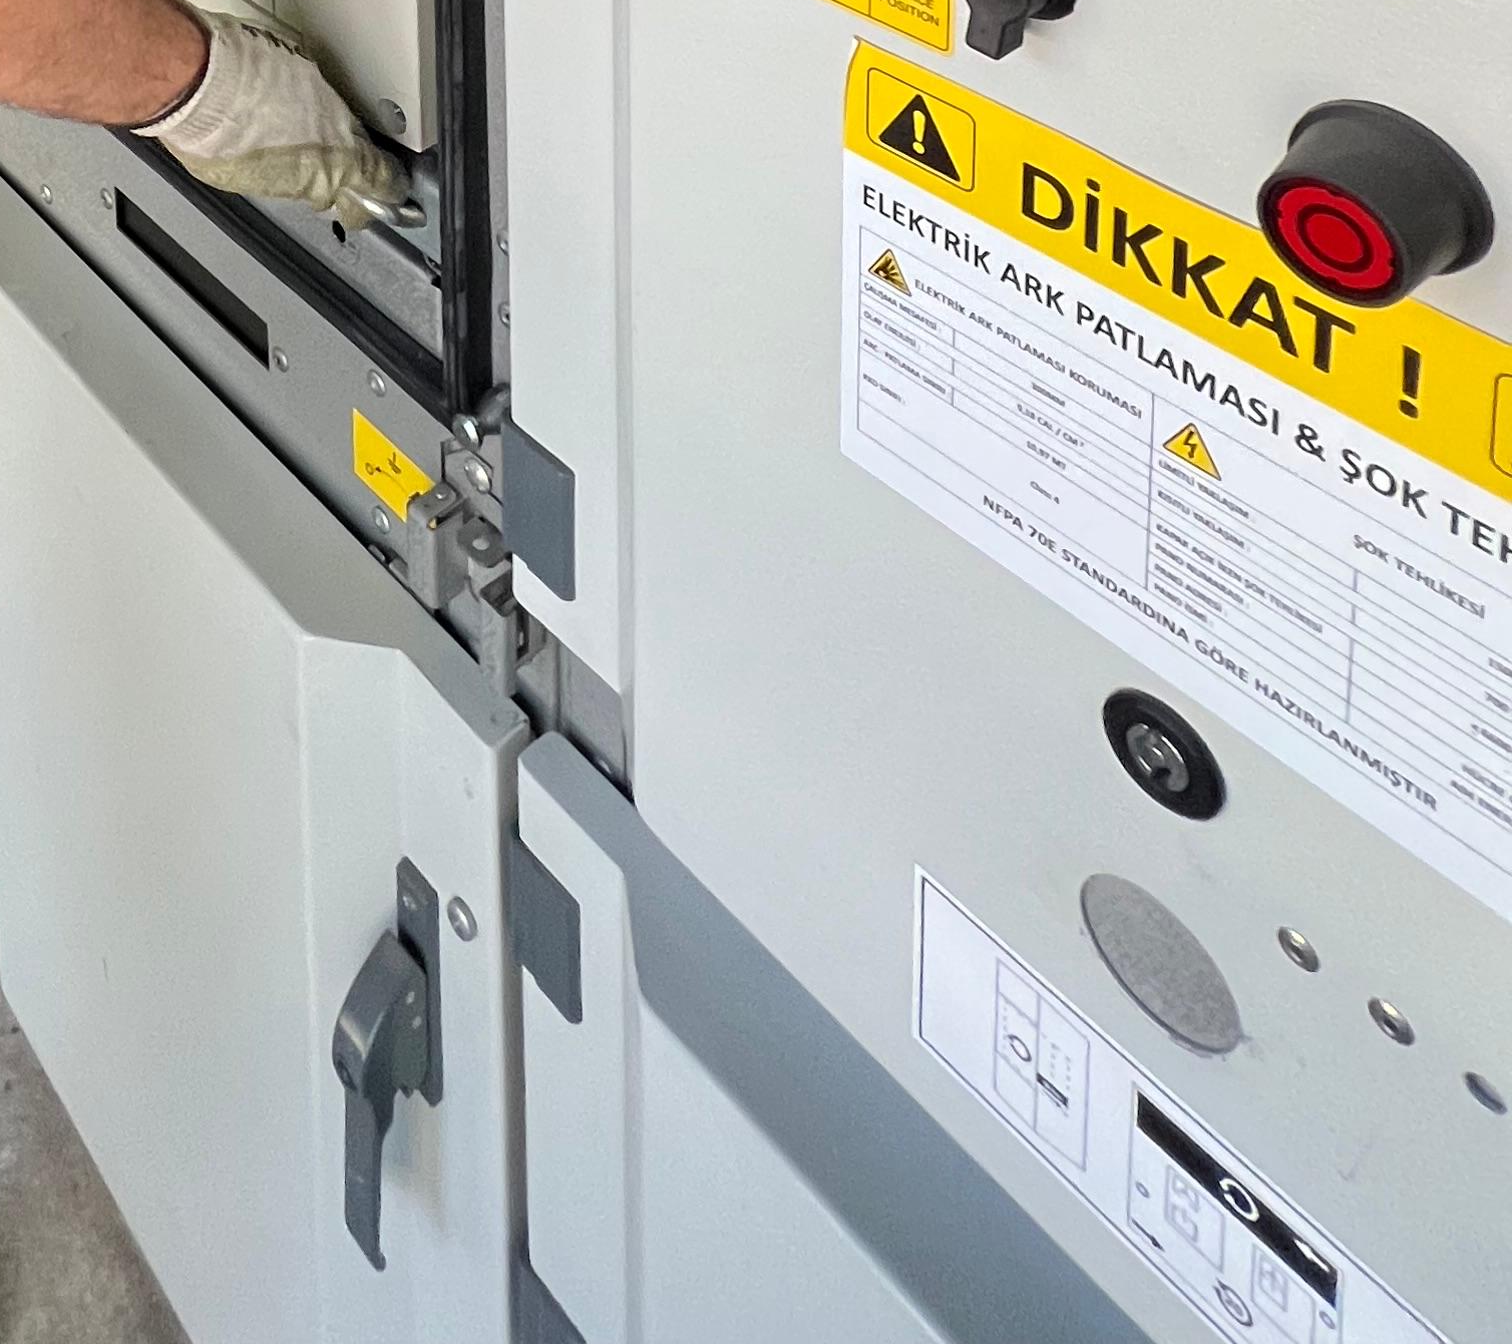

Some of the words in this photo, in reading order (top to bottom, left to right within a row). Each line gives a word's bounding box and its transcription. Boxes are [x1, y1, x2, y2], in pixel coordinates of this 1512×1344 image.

[863, 184, 991, 275] ELEKTRİK
[1000, 262, 1065, 317] ARK
[1076, 301, 1280, 436] PATLAMASI
[1294, 423, 1326, 462] &
[1339, 448, 1429, 520] ŞOK
[914, 279, 966, 315] ELEKTRİK
[968, 311, 993, 333] ARK
[996, 327, 1066, 374] PATLAMASI
[1069, 369, 1143, 420] KORUMASI
[1021, 162, 1357, 375] DİKKAT
[983, 494, 1024, 532] NFPA
[1027, 524, 1058, 555] 70E
[1061, 547, 1190, 644] STANDARDINA
[1194, 638, 1249, 684] GÖRE
[1254, 678, 1438, 812] HAZIRLANMIŞTIR
[1353, 534, 1389, 563] ŞOK
[1393, 556, 1486, 619] TEHLİKESİ
